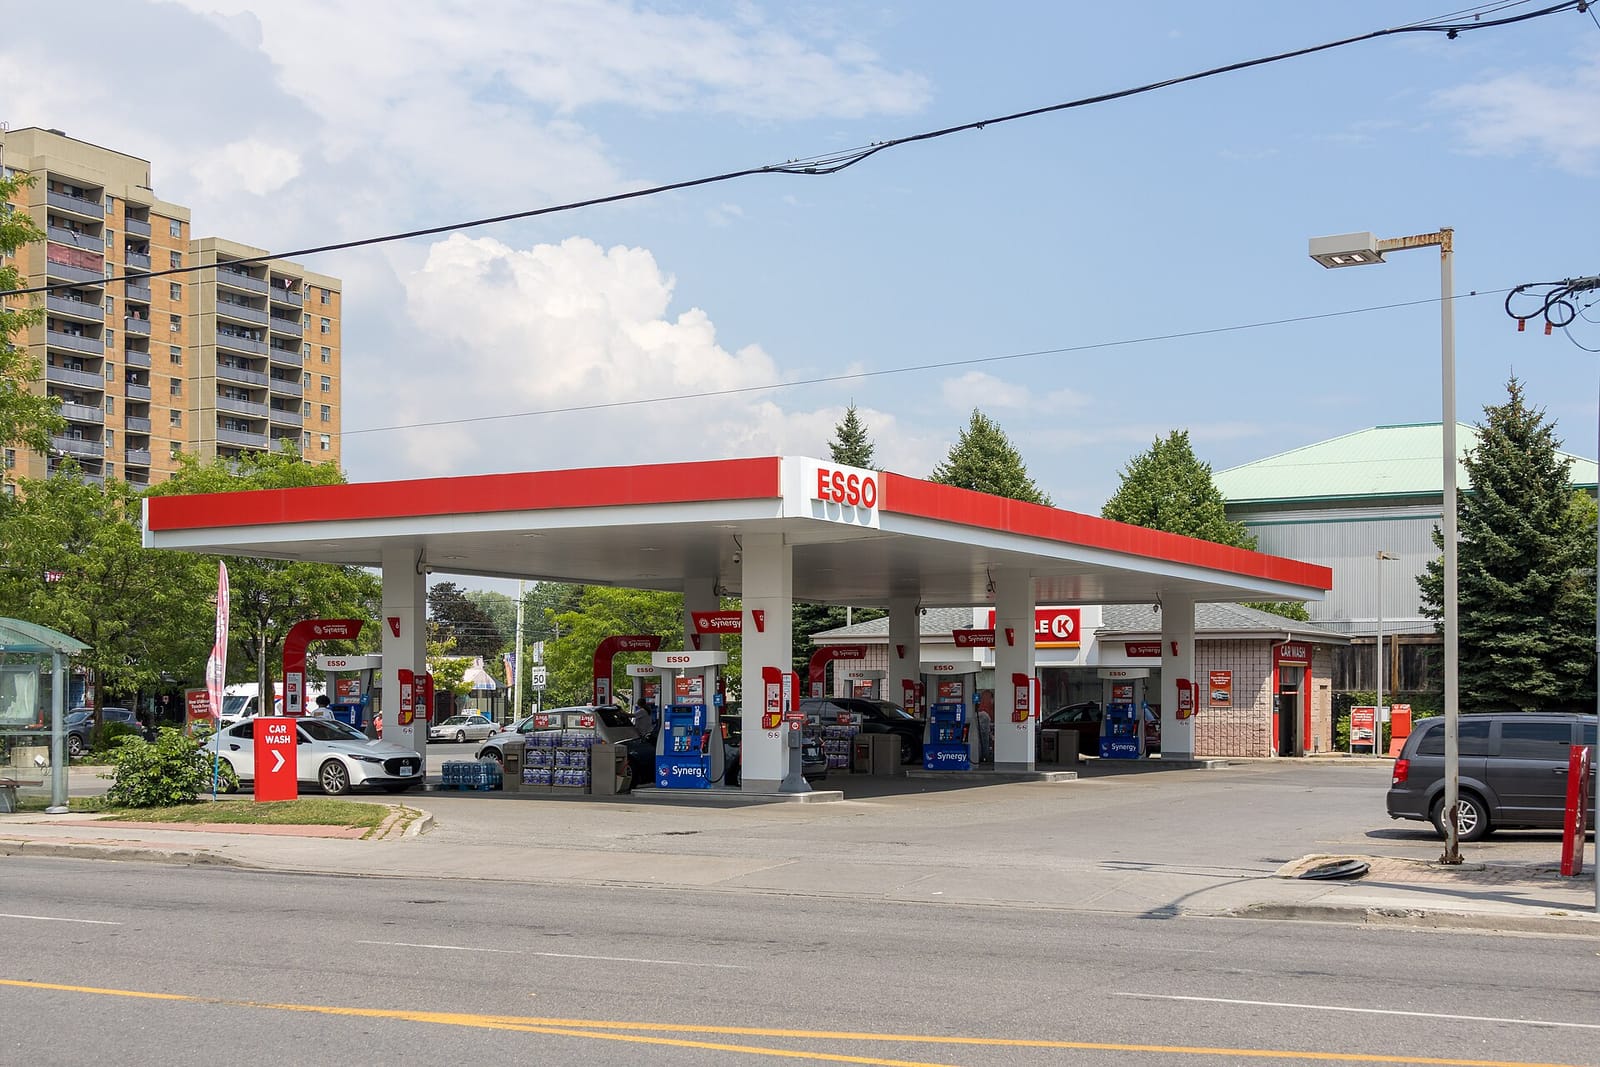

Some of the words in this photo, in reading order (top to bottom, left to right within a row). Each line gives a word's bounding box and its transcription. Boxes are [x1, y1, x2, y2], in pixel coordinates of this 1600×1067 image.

[818, 468, 876, 508] ESSO
[711, 619, 741, 628] Synergy
[968, 635, 994, 643] Synergy
[1281, 645, 1291, 657] CAR
[1291, 646, 1306, 658] WASH
[533, 674, 545, 684] 50
[269, 725, 287, 734] CAR
[265, 735, 291, 744] WASH
[1111, 743, 1136, 751] Synergy
[937, 751, 967, 761] Synergy
